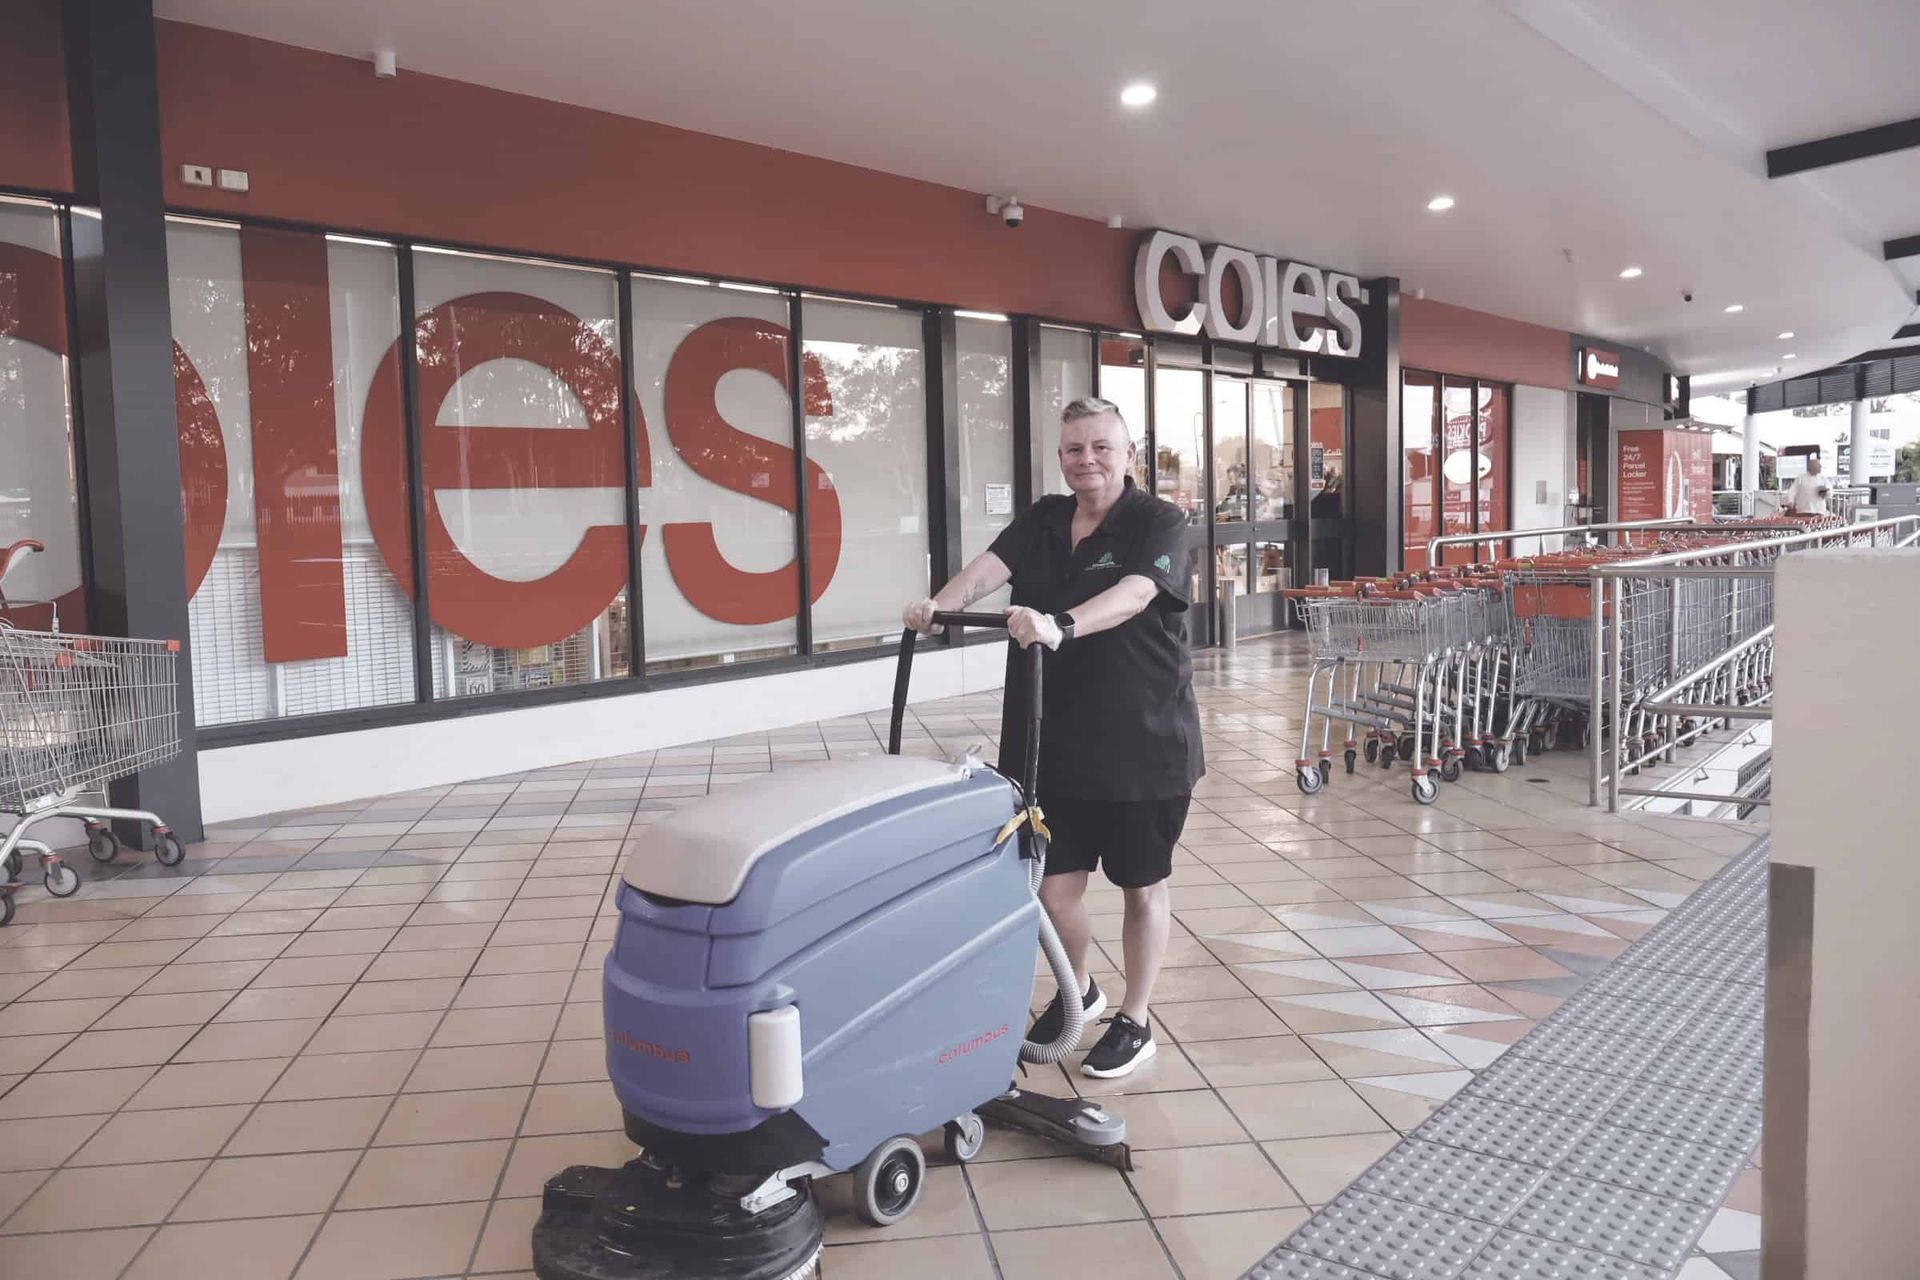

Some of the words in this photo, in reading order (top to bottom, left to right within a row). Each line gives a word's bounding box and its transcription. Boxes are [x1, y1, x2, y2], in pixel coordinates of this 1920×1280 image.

[1135, 230, 1362, 358] coles
[1623, 453, 1641, 461] 24/7
[1623, 470, 1647, 478] Locker
[938, 1023, 1009, 1066] columbus
